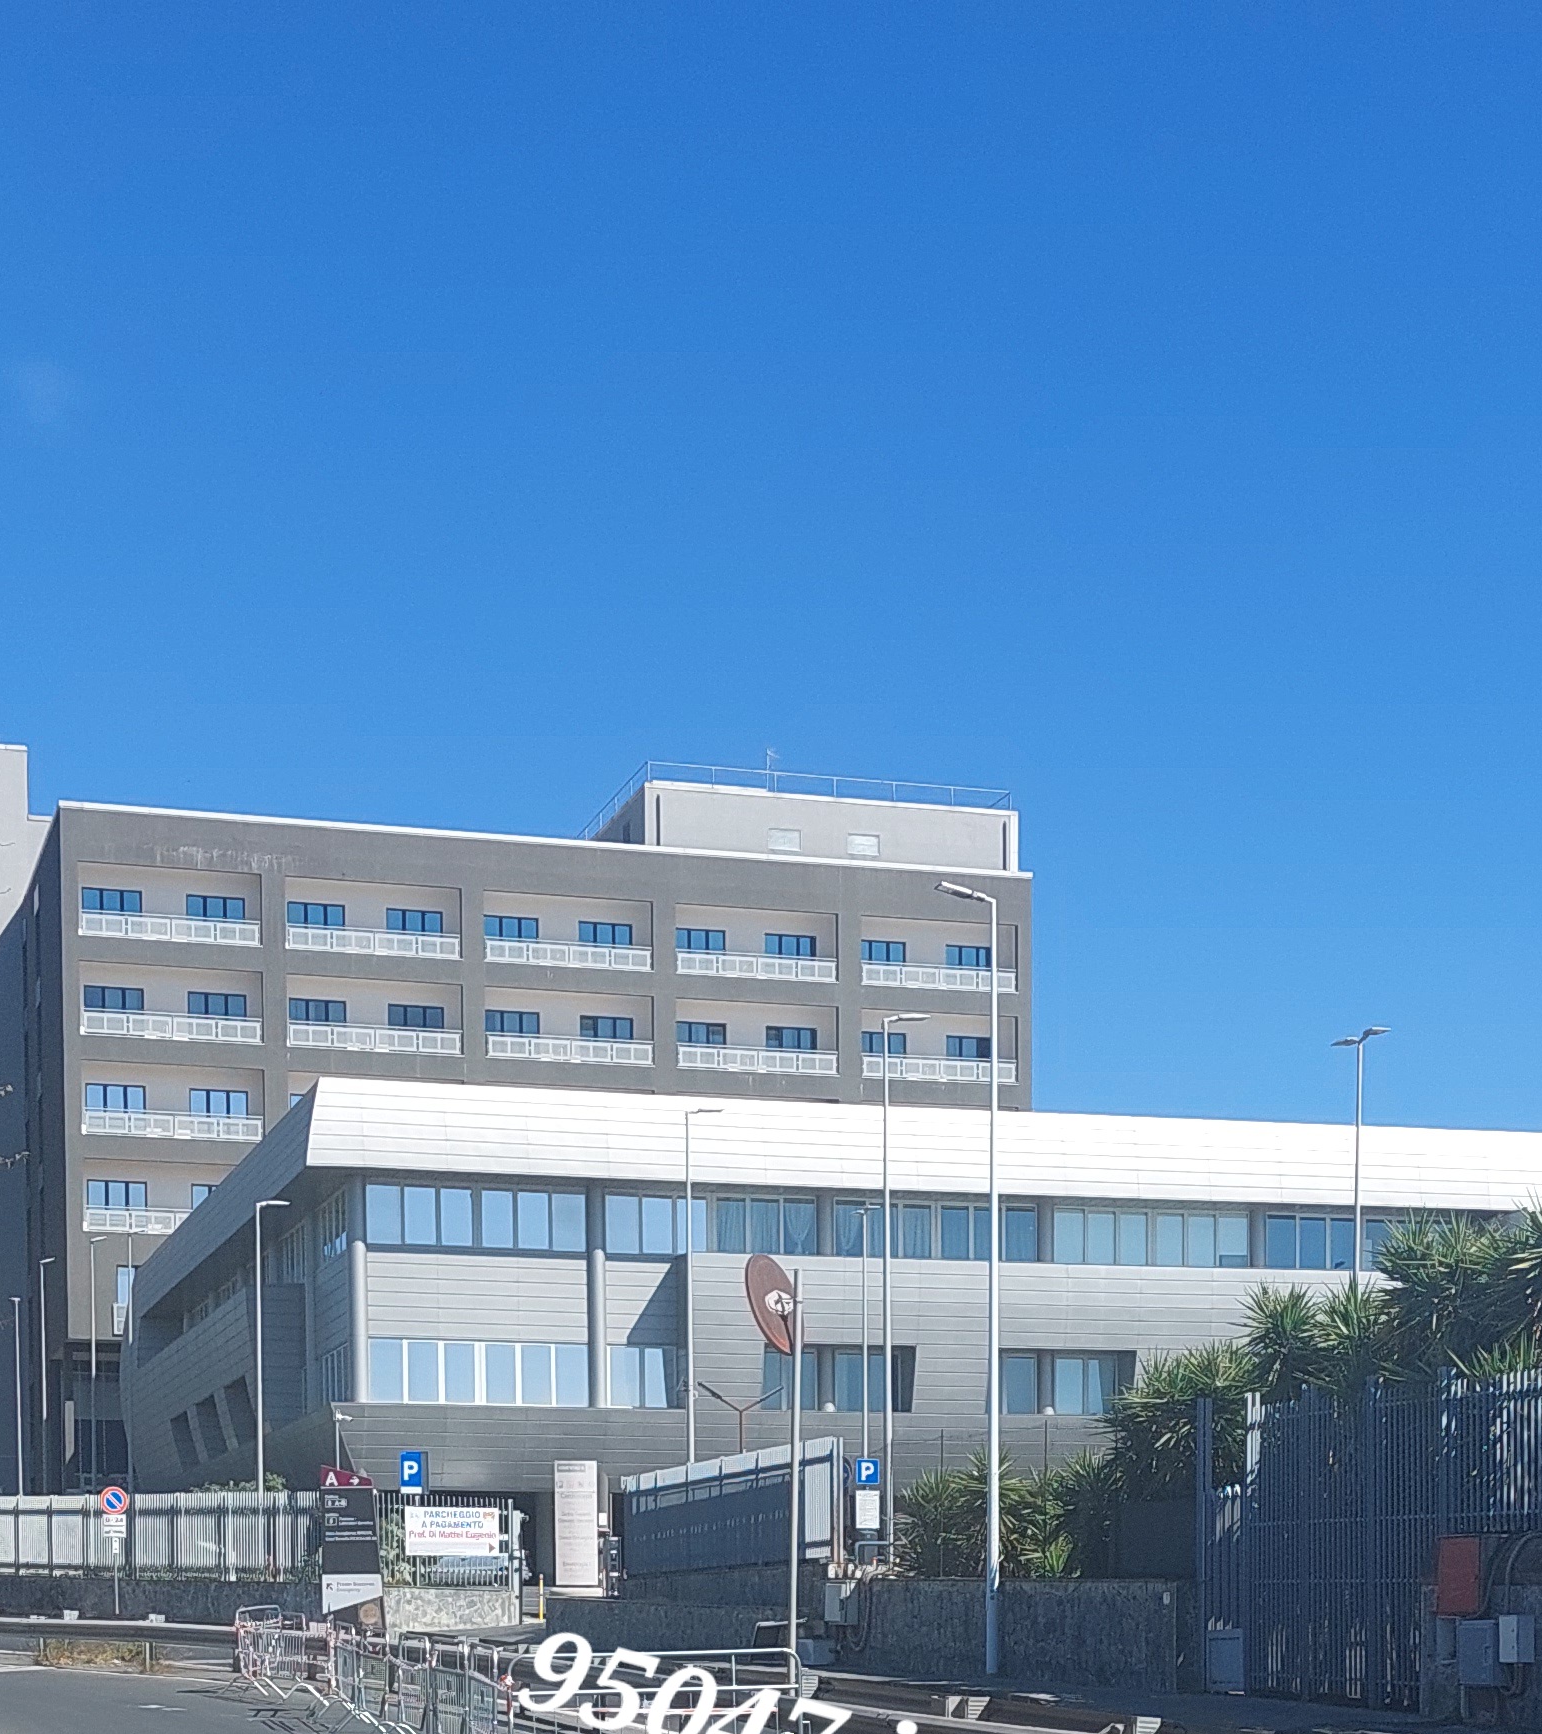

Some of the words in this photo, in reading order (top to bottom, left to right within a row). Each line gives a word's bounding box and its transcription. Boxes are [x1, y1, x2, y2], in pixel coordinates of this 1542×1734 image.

[403, 1460, 419, 1481] P
[861, 1461, 875, 1481] P
[325, 1471, 338, 1487] A
[423, 1510, 481, 1519] PARCHEGGIO
[430, 1520, 483, 1529] PAGAMENTO
